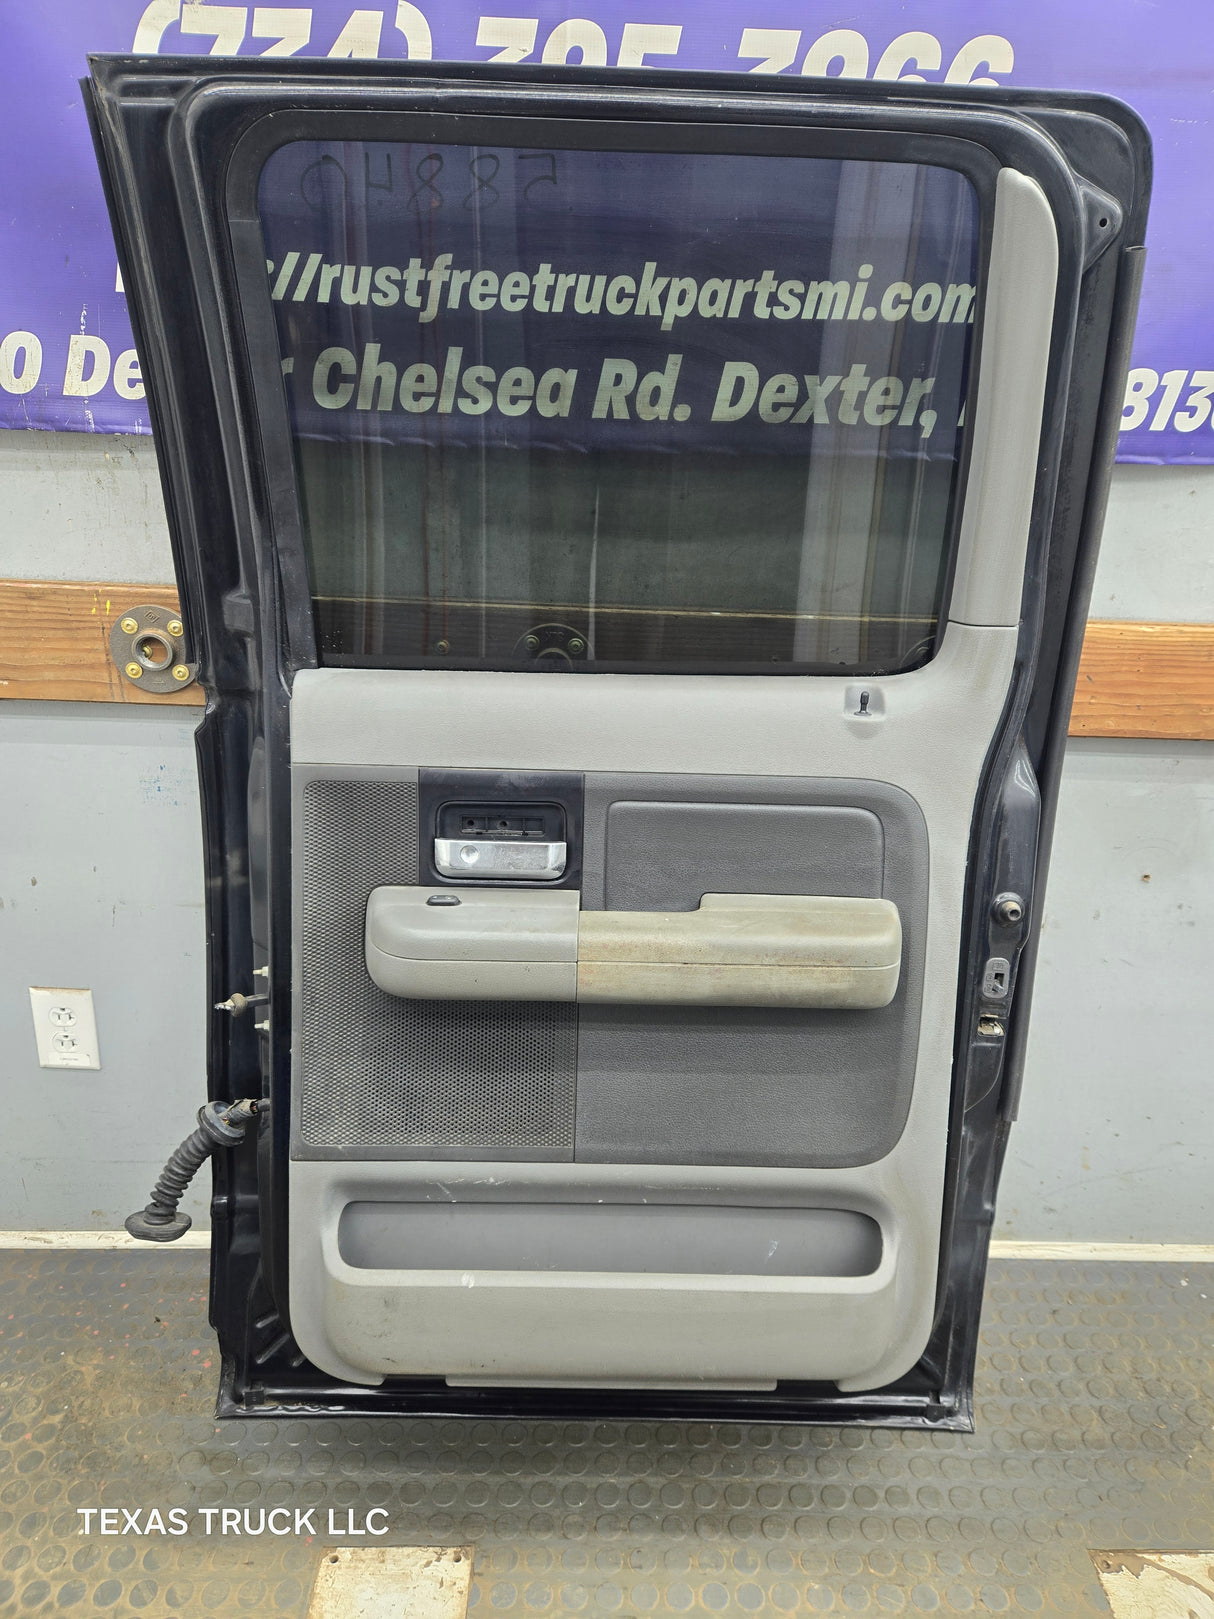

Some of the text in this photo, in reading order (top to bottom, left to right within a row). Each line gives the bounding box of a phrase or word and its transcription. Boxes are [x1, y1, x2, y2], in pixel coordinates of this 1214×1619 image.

[266, 251, 976, 331] //rustfreetruckpartsmi.com
[312, 343, 578, 418] Chelsea
[592, 353, 692, 422] Rd.
[711, 361, 938, 438] Dexter,
[1119, 367, 1214, 433] 813
